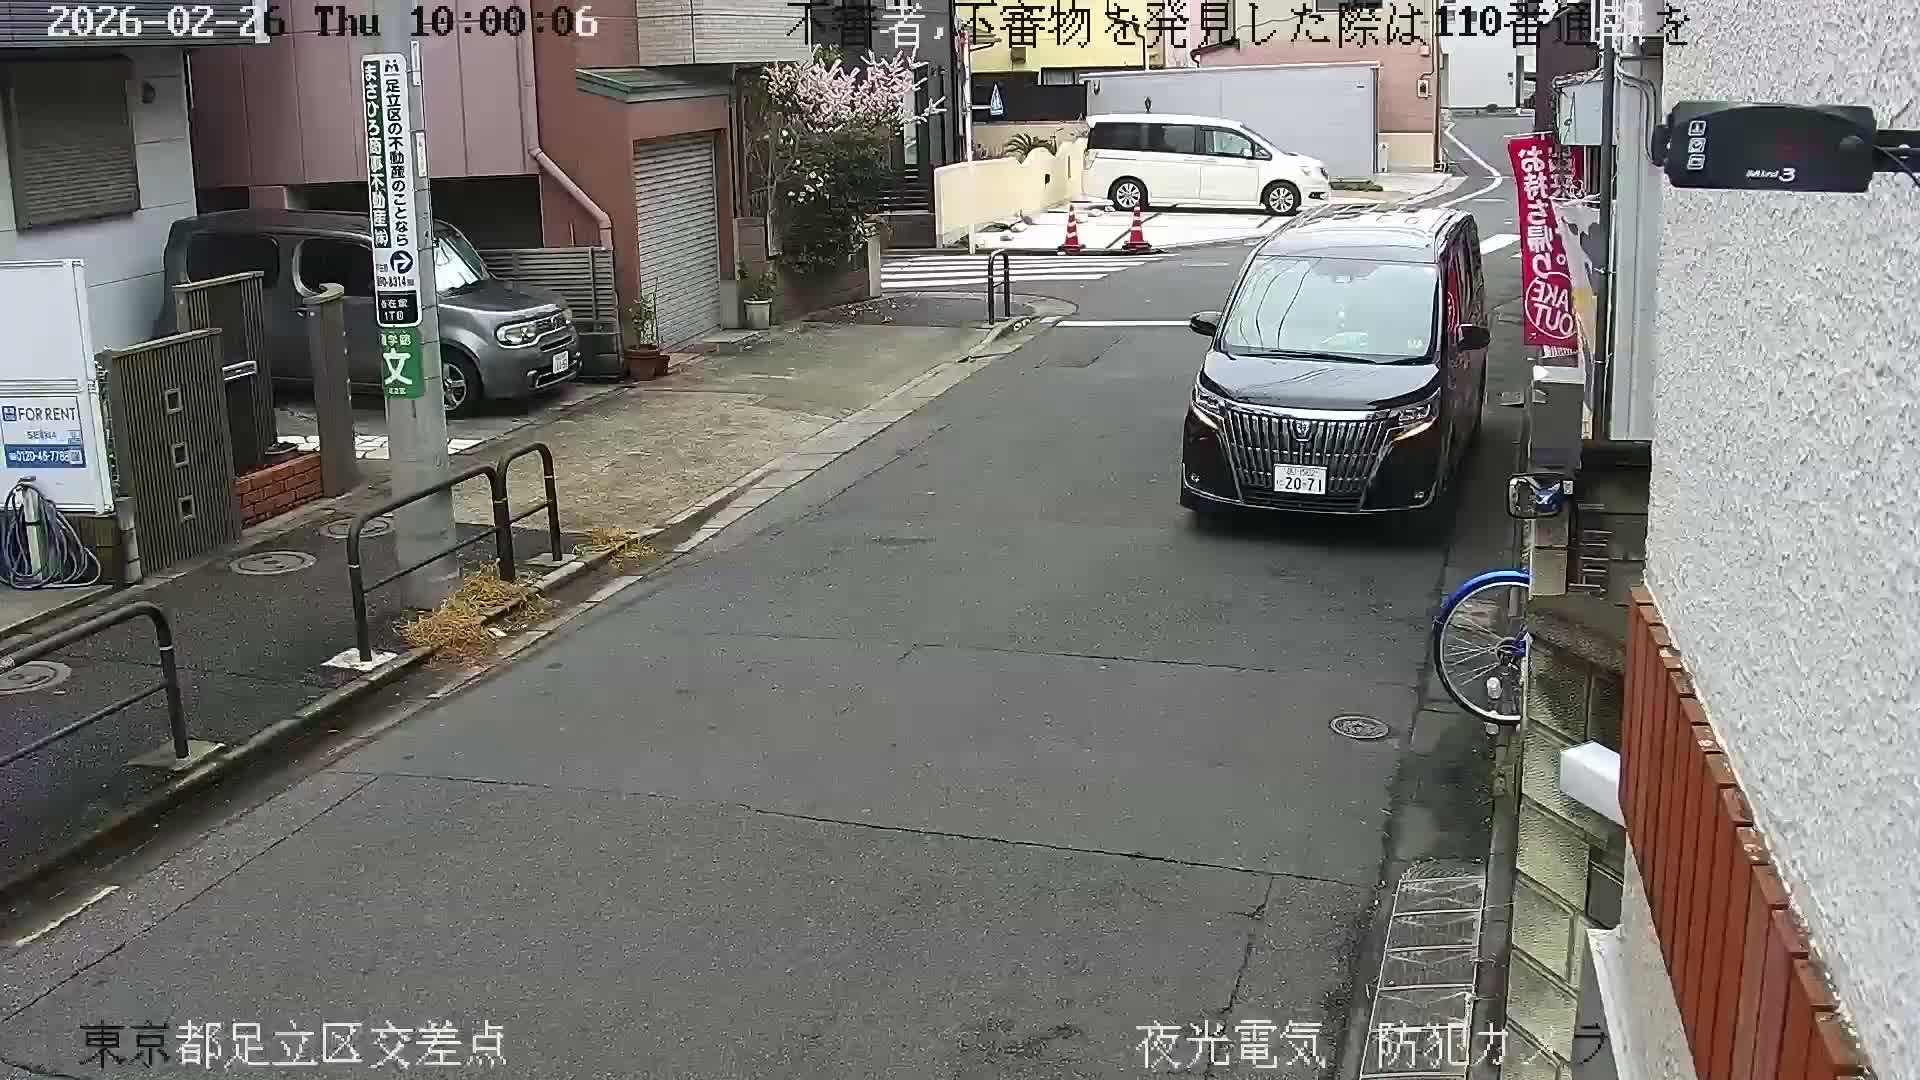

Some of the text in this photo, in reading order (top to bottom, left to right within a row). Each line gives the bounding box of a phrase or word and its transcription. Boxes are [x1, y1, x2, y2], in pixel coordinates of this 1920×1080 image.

[385, 78, 409, 247] 足立区の不動産のことなら
[382, 347, 413, 385] 文
[17, 407, 76, 421] FOR RENT
